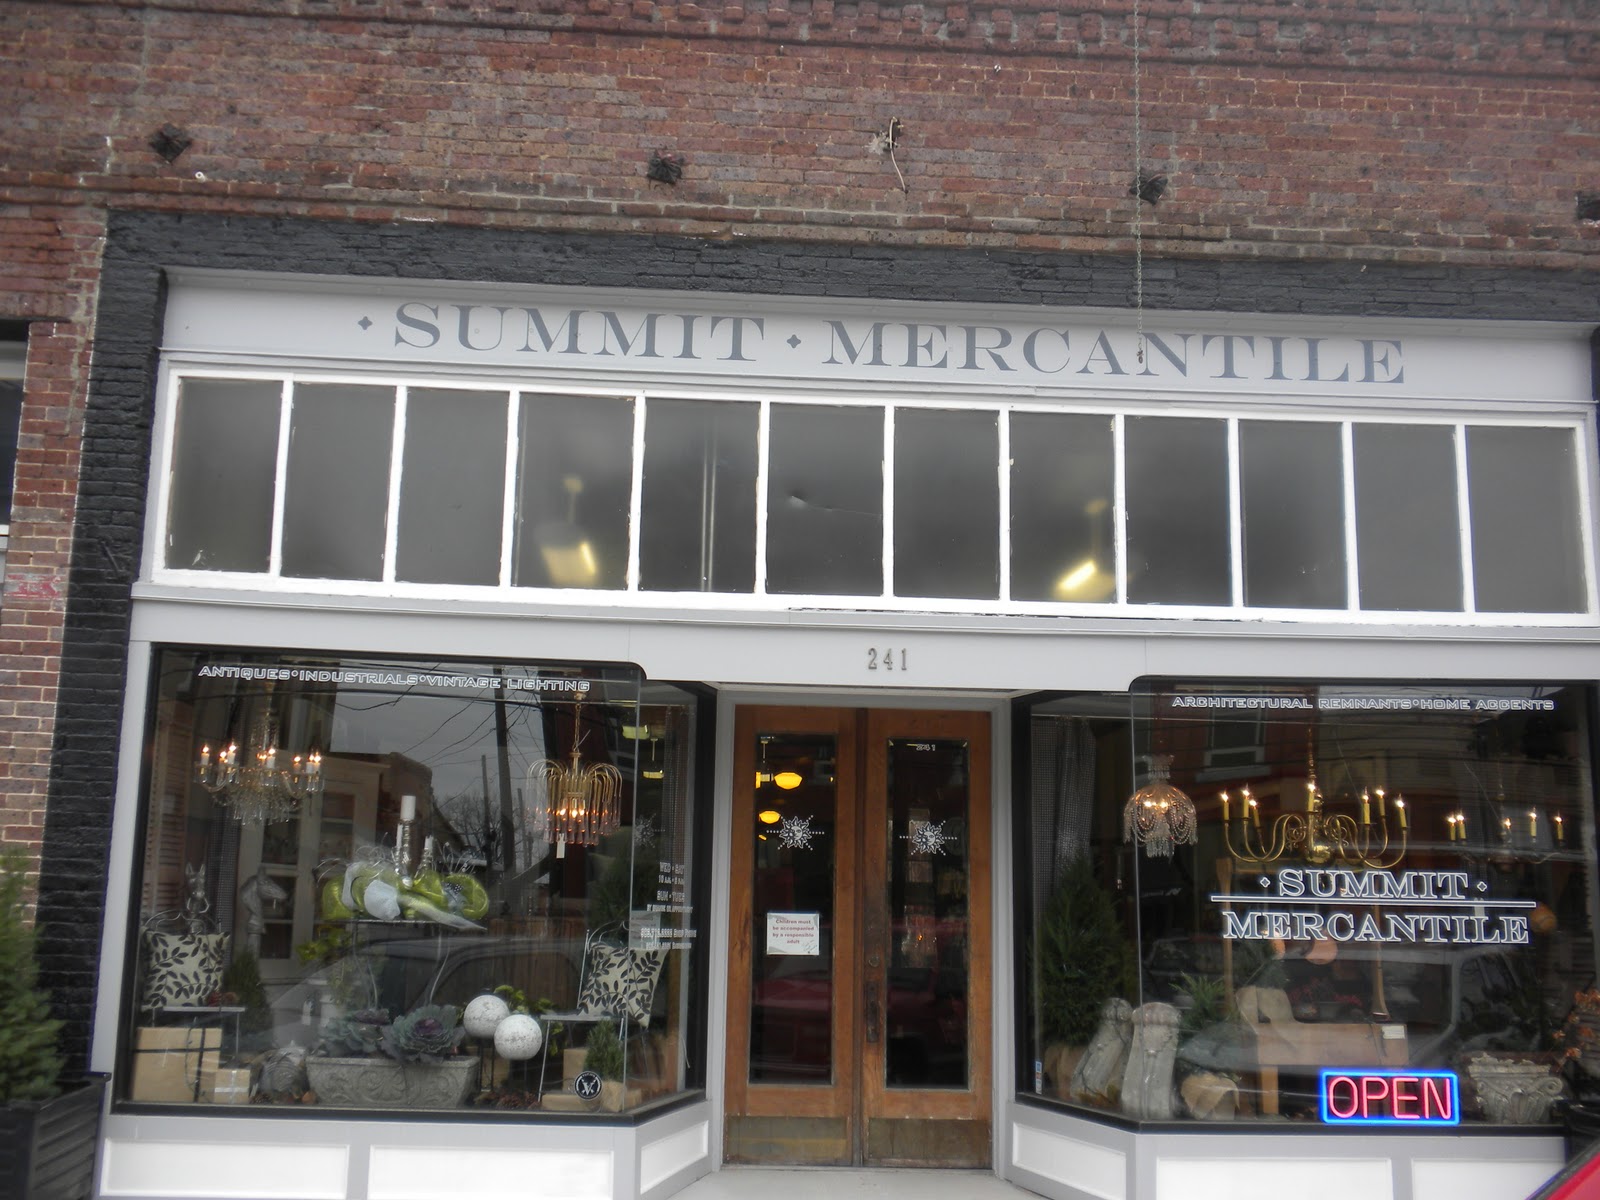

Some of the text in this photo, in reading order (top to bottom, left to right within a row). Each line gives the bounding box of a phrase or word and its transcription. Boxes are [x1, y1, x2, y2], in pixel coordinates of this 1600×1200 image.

[394, 302, 1405, 384] SUMMIT MERCANTILE
[867, 647, 908, 671] 241
[198, 665, 590, 692] ANTIQUES INDUSTRIALS VINTAGE LIGHTING
[1172, 696, 1555, 711] ARCHITECTURAL REMNANTS HOME ACCENTS
[1279, 868, 1468, 900] SUMMIT
[1222, 911, 1529, 943] MERCANTILE
[1329, 1076, 1451, 1120] OPEN
